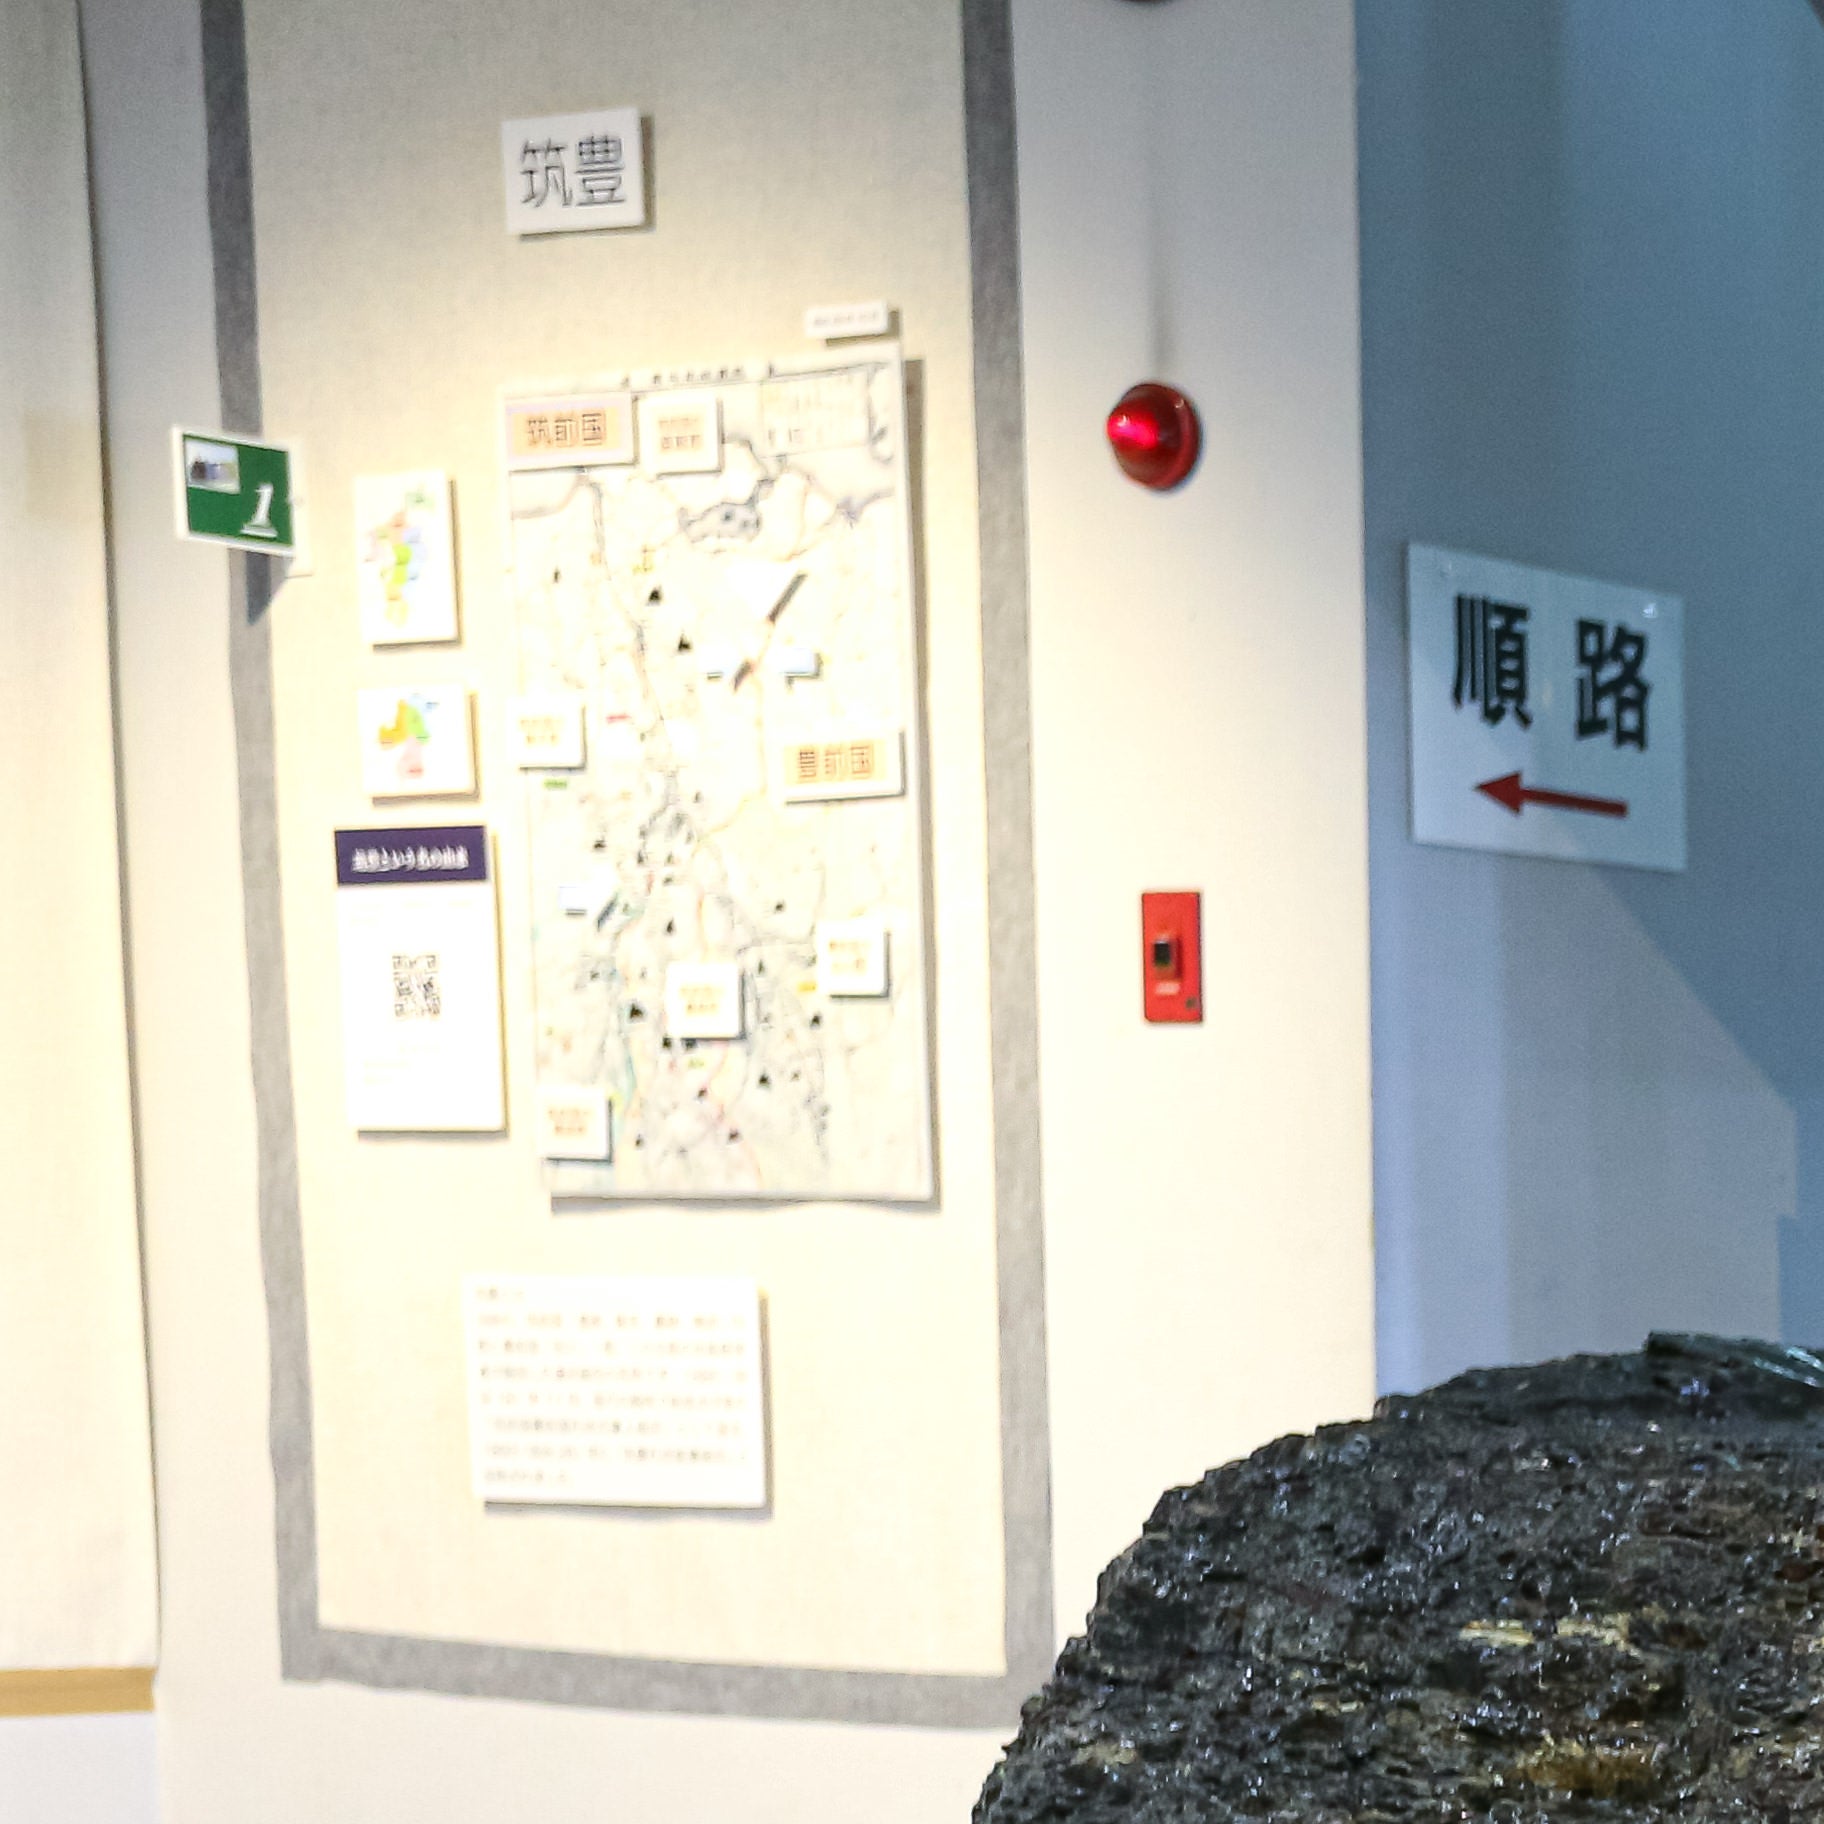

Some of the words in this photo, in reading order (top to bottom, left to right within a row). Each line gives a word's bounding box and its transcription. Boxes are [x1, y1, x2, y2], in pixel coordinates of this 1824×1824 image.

[519, 132, 627, 210] 筑豊
[240, 481, 279, 538] 1
[1453, 593, 1652, 751] 順路
